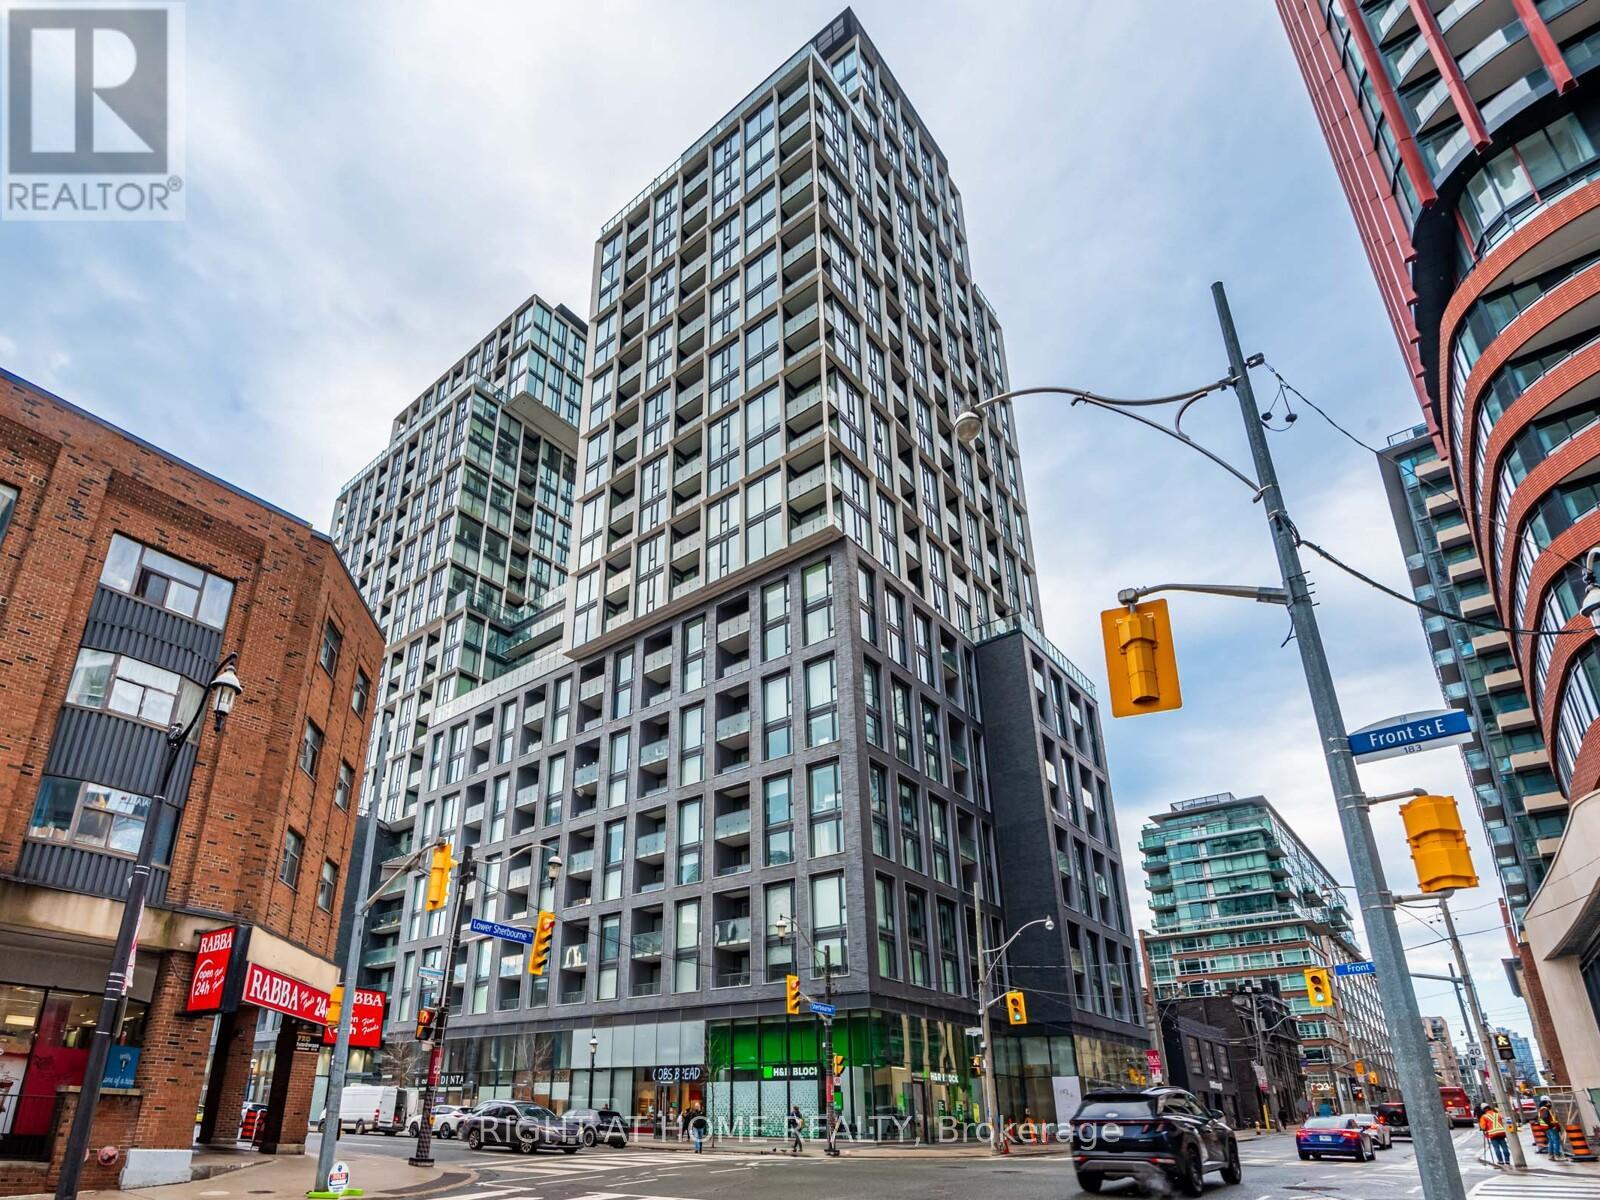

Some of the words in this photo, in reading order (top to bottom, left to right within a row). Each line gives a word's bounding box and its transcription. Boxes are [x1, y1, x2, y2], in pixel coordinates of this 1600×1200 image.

[1369, 726, 1414, 747] Front
[1418, 724, 1432, 737] St
[1435, 719, 1446, 734] E
[1404, 744, 1422, 754] 183
[473, 920, 492, 932] Lower
[493, 925, 527, 940] Sherbourne
[200, 932, 232, 953] RABBA
[1346, 963, 1370, 973] Front
[195, 980, 211, 995] 24h
[249, 969, 298, 1011] RABBA
[314, 996, 328, 1018] 24
[1469, 1048, 1481, 1056] 40
